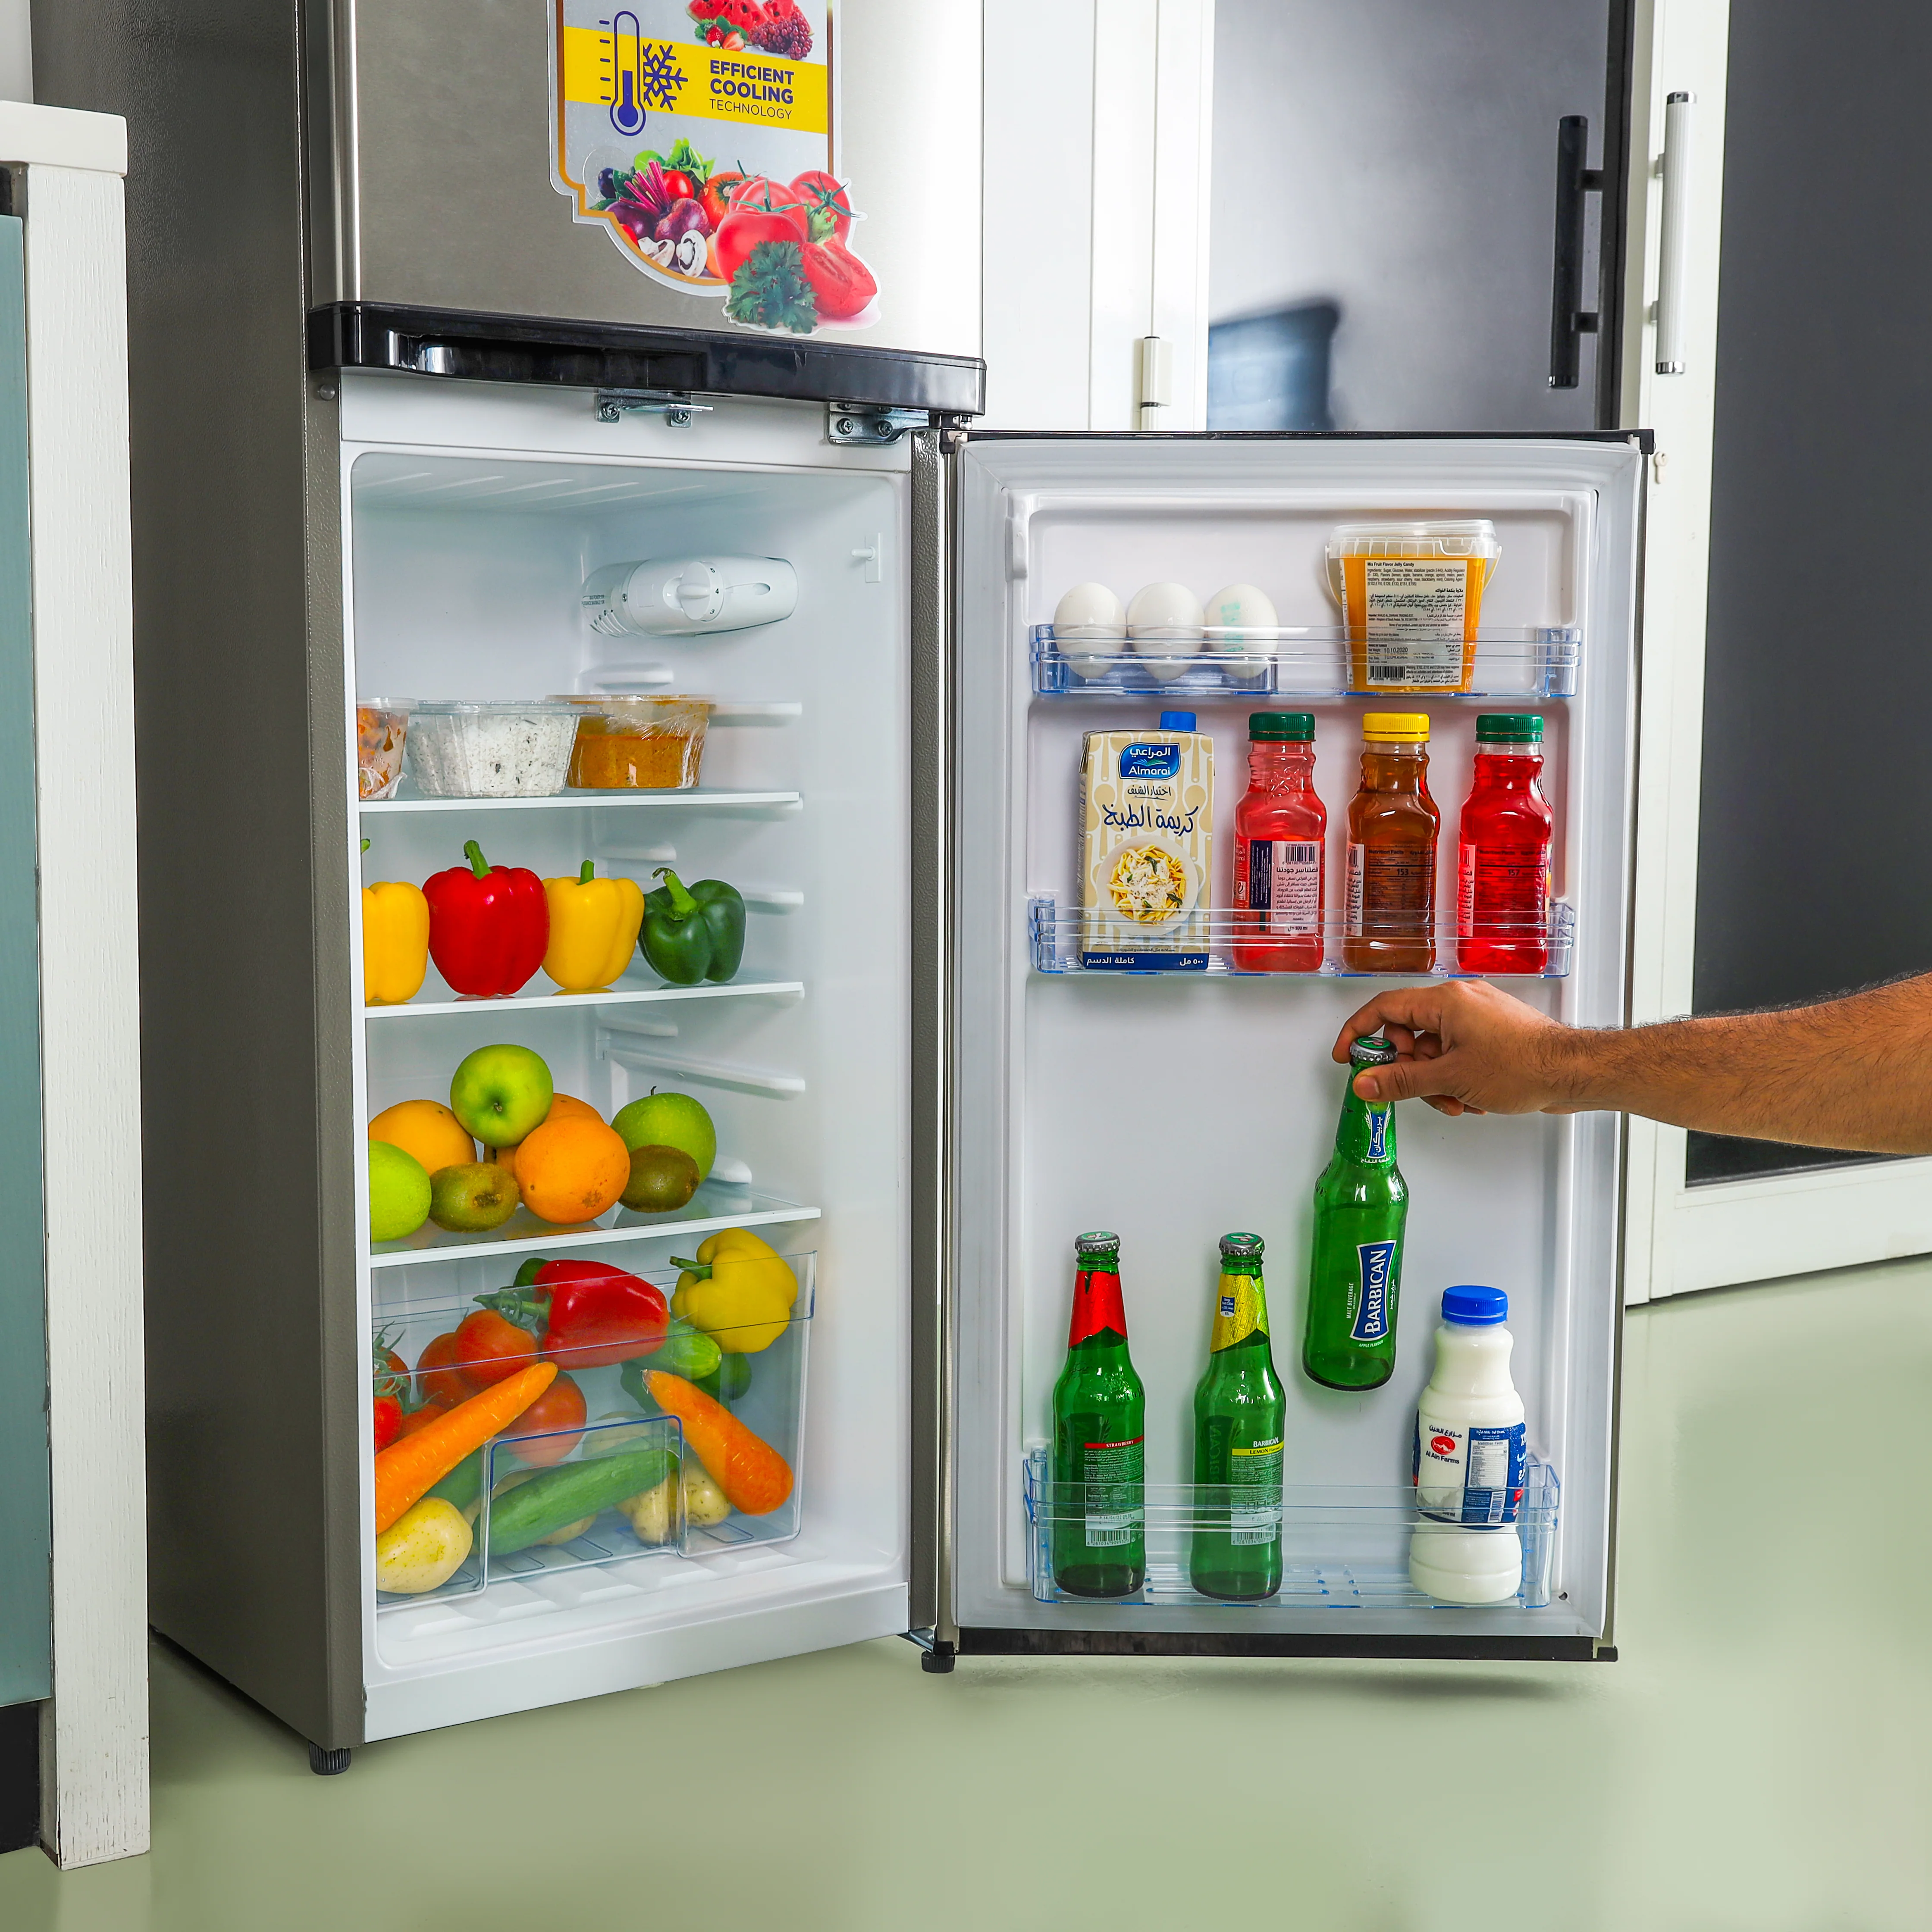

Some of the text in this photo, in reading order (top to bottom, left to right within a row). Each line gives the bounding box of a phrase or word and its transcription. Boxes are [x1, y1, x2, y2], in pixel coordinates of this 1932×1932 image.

[710, 60, 794, 85] EFFICIENT
[710, 78, 794, 104] COOLING
[709, 98, 792, 120] TECHNOLOGY
[1129, 747, 1171, 759] المراعي
[1128, 766, 1171, 775] Almarai
[1127, 785, 1171, 798] اختيار الشيف
[1102, 804, 1199, 836] كريمة الطبخ
[1086, 957, 1112, 966] الدسم
[1179, 957, 1191, 966] مل
[1373, 1116, 1383, 1153] بربيكان
[1364, 1249, 1386, 1334] BARBICAN
[1429, 1425, 1462, 1438] مزارع العين
[1253, 1436, 1279, 1448] BARBICAN
[1441, 1455, 1460, 1464] Farms
